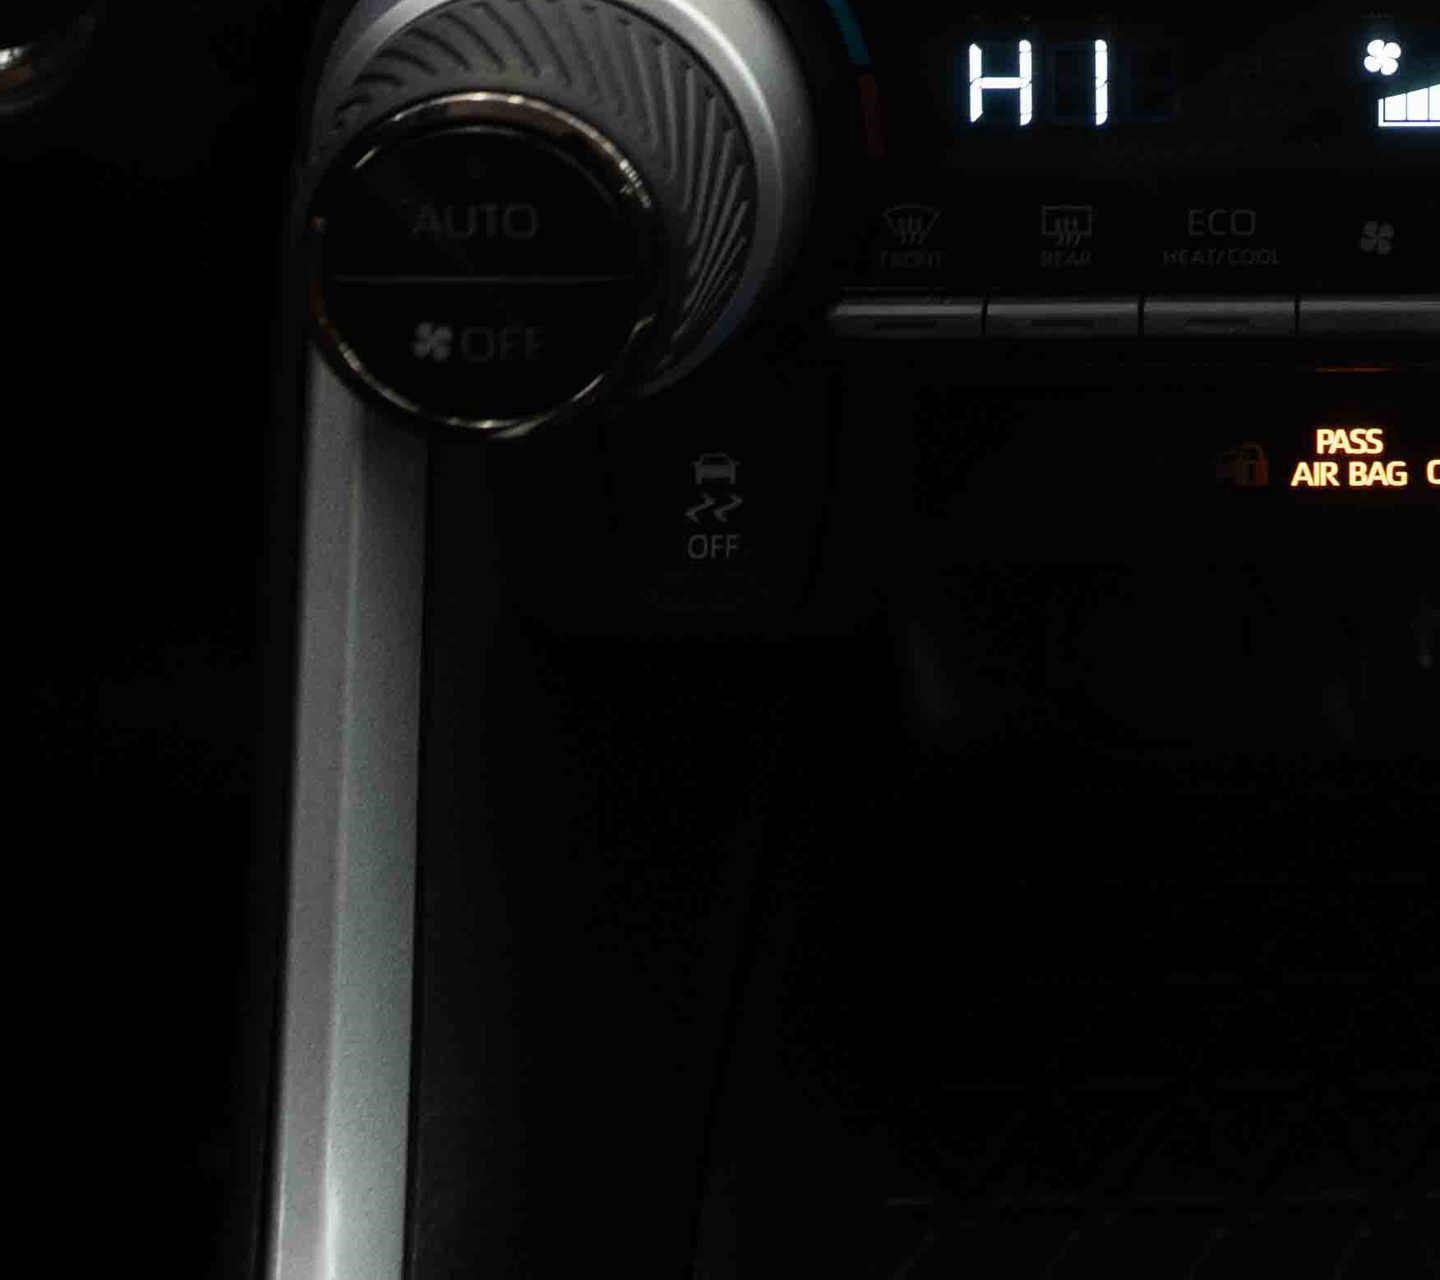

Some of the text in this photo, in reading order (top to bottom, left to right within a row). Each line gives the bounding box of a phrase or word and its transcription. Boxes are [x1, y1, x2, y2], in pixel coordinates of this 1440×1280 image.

[968, 38, 1109, 127] HI
[410, 202, 539, 240] AUTO
[1186, 208, 1256, 236] ECO
[460, 324, 546, 363] OFF
[1316, 428, 1383, 454] PASS
[1290, 461, 1340, 487] AIR
[1348, 461, 1408, 487] BAG
[687, 533, 742, 560] OFF
